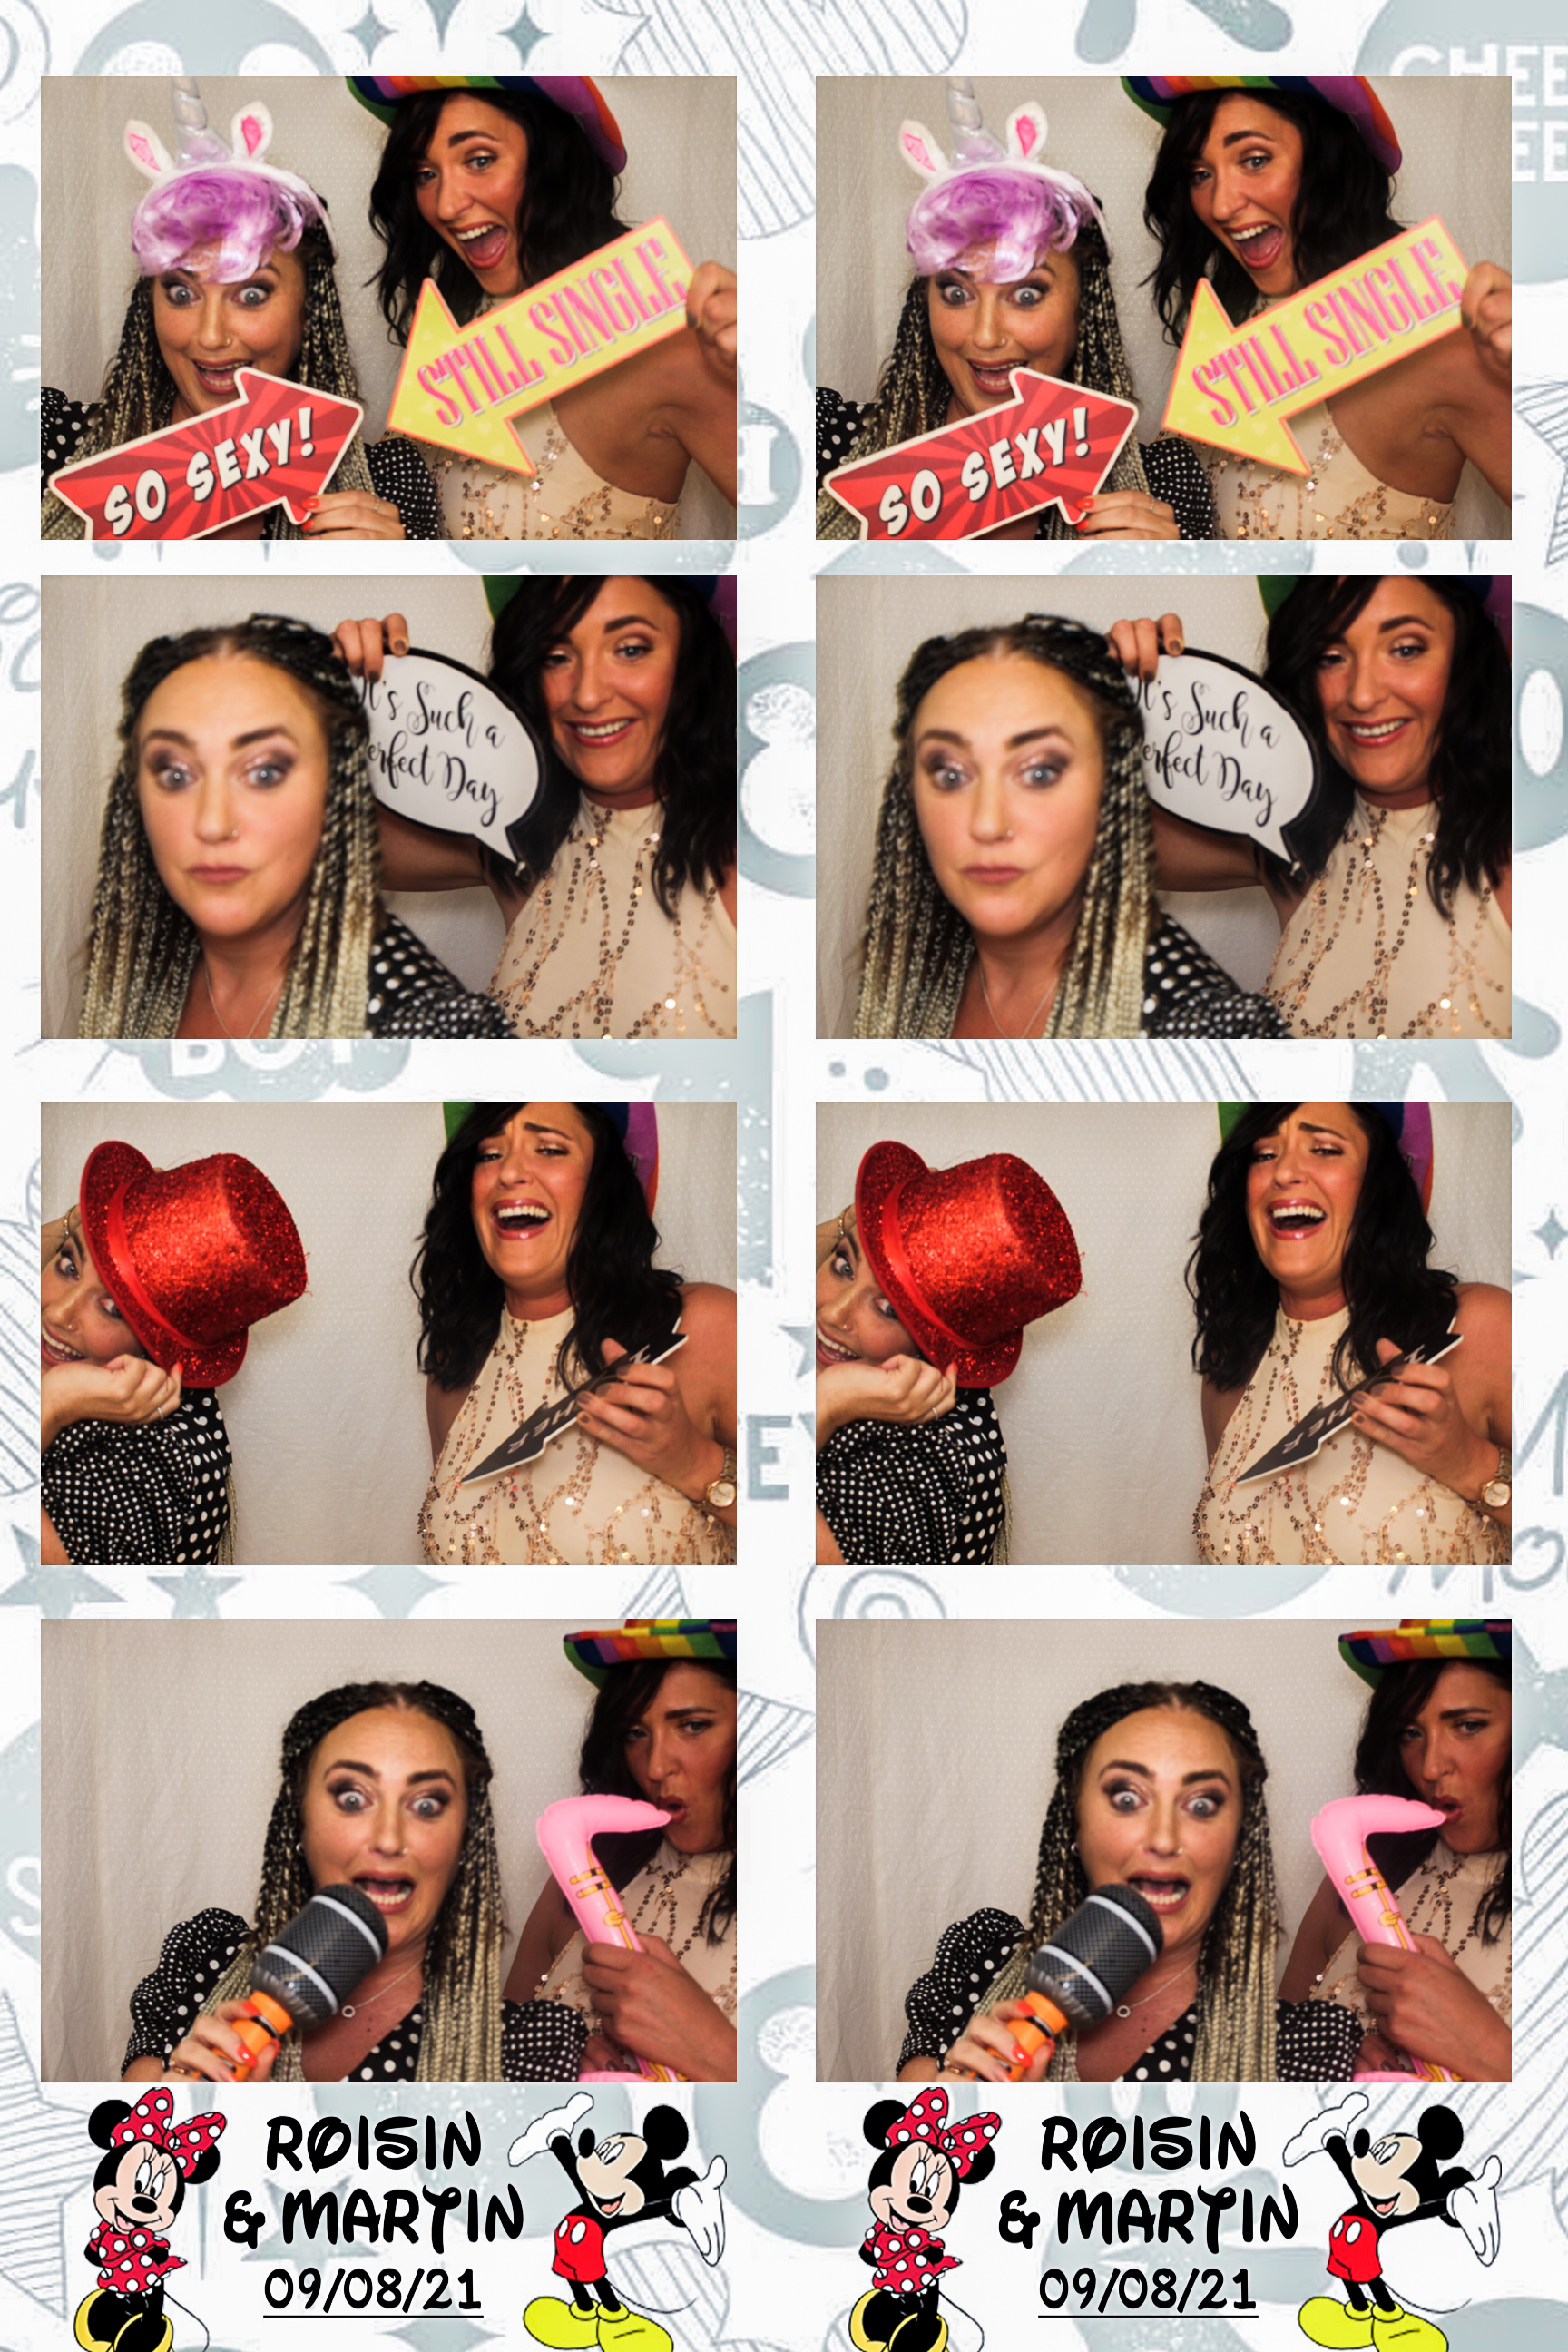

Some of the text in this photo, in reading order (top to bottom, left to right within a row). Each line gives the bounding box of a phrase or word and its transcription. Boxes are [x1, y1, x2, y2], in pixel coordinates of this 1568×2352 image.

[417, 238, 687, 427] STILL SINGLE
[1192, 238, 1462, 427] STILL SINGLE
[103, 407, 315, 536] SO SEXY!
[878, 407, 1090, 536] SO SEXY!
[407, 681, 476, 748] Such
[485, 725, 505, 749] a
[1181, 681, 1251, 748] Such
[1260, 725, 1280, 749] a
[367, 730, 504, 828] erfect Day
[1142, 730, 1279, 828] erfect Day
